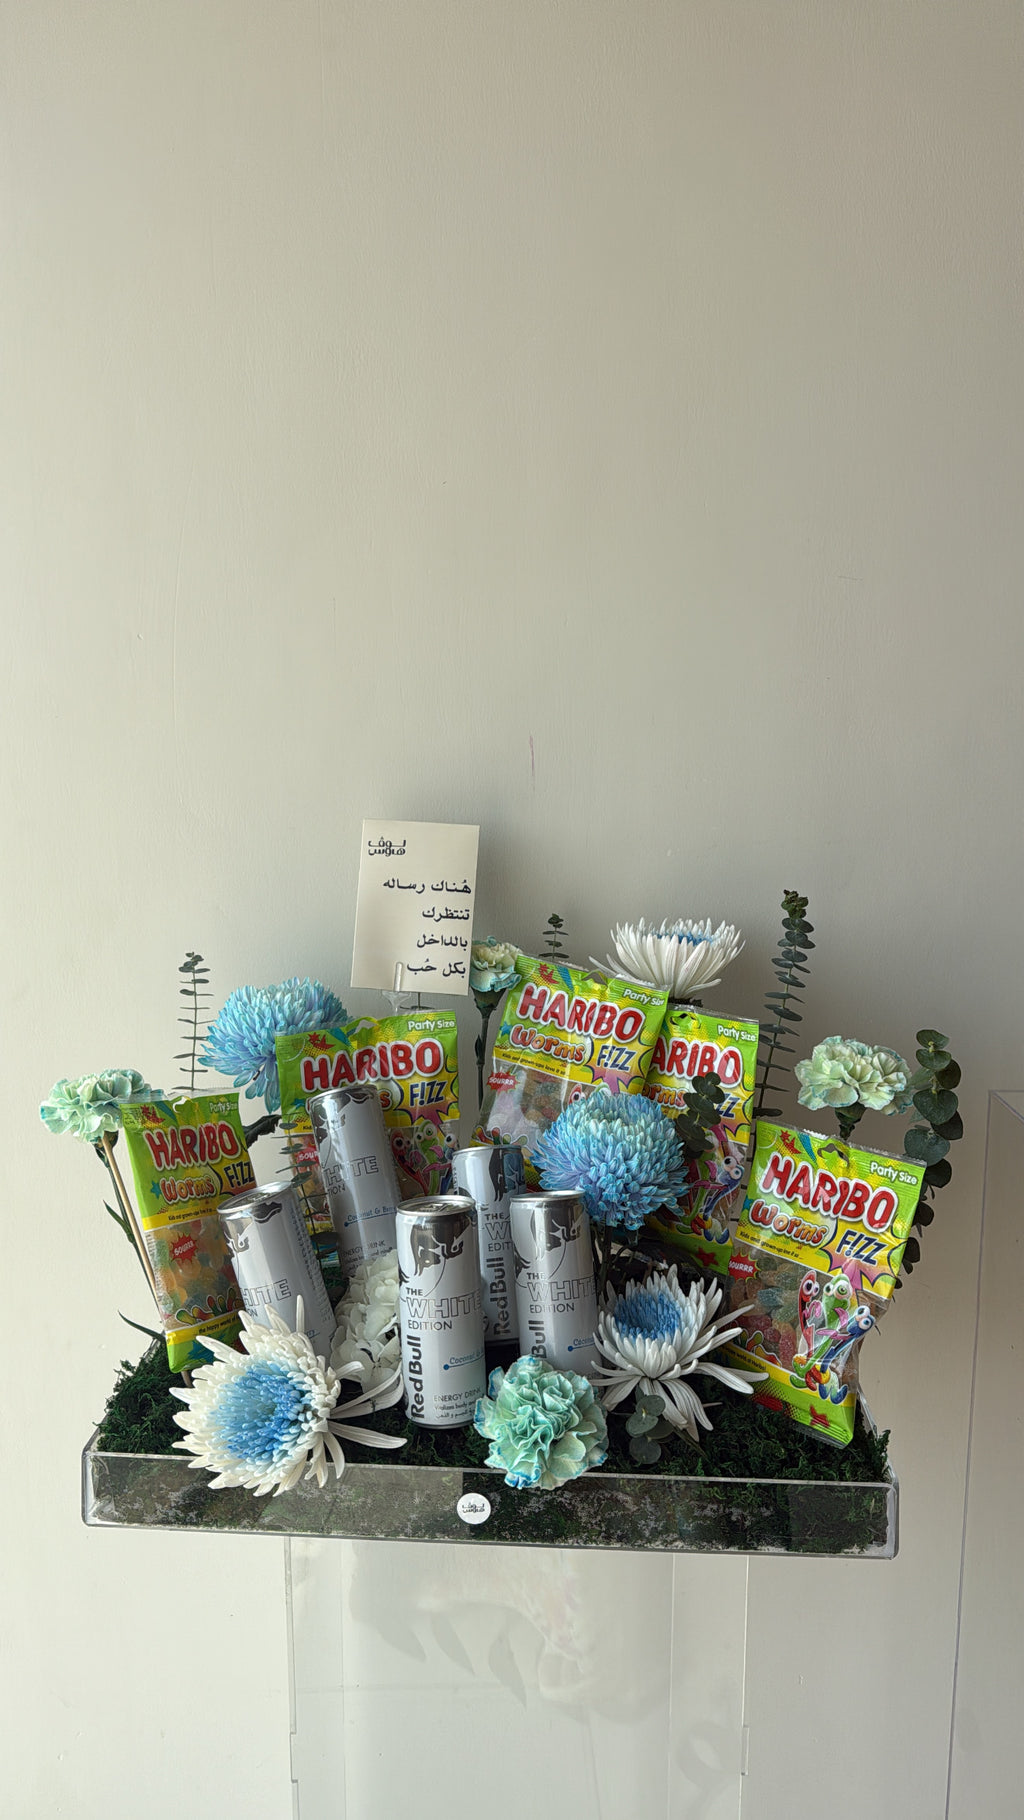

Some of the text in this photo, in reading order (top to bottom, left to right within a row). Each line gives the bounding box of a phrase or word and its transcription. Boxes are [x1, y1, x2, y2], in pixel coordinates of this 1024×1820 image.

[422, 907, 470, 922] تنتظرك
[417, 934, 468, 951] بالداخل
[442, 961, 466, 979] بكل
[623, 989, 650, 1005] Party
[516, 983, 645, 1043] HARIBO
[408, 1020, 455, 1031] Party Size
[717, 1025, 756, 1042] Party Size
[302, 1038, 443, 1092] HARIBO
[651, 1036, 743, 1088] ARIBO
[642, 1084, 688, 1109] orms
[143, 1121, 241, 1171] HARIBO
[870, 1161, 918, 1185] Party Size
[761, 1152, 898, 1232] HARIBO
[485, 1213, 505, 1221] THE
[488, 1241, 513, 1252] EDIT
[486, 1257, 507, 1294] Bull
[527, 1272, 546, 1280] THE
[240, 1279, 292, 1307] HITE
[406, 1287, 424, 1297] THE
[406, 1293, 482, 1319] WHITE
[489, 1296, 511, 1336] Red
[529, 1302, 576, 1314] EDITION
[407, 1320, 453, 1331] EDITION
[528, 1320, 547, 1359] Bull
[406, 1334, 425, 1418] Red Bull
[434, 1393, 463, 1402] ENERGY
